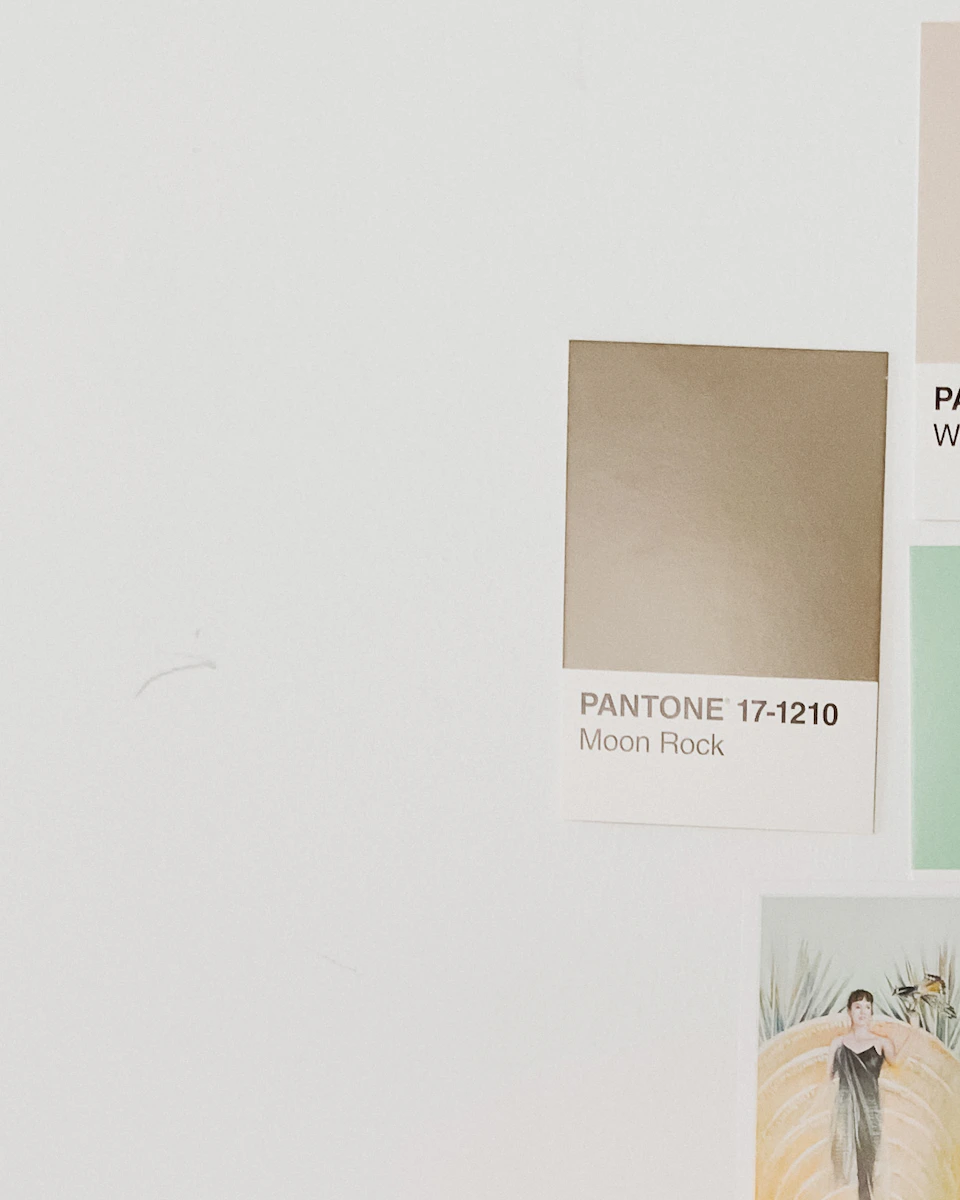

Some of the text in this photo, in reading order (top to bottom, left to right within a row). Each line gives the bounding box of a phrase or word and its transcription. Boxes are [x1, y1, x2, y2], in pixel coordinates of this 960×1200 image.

[580, 692, 839, 726] PANTONE 17-1210
[580, 728, 725, 756] Moon Rock
